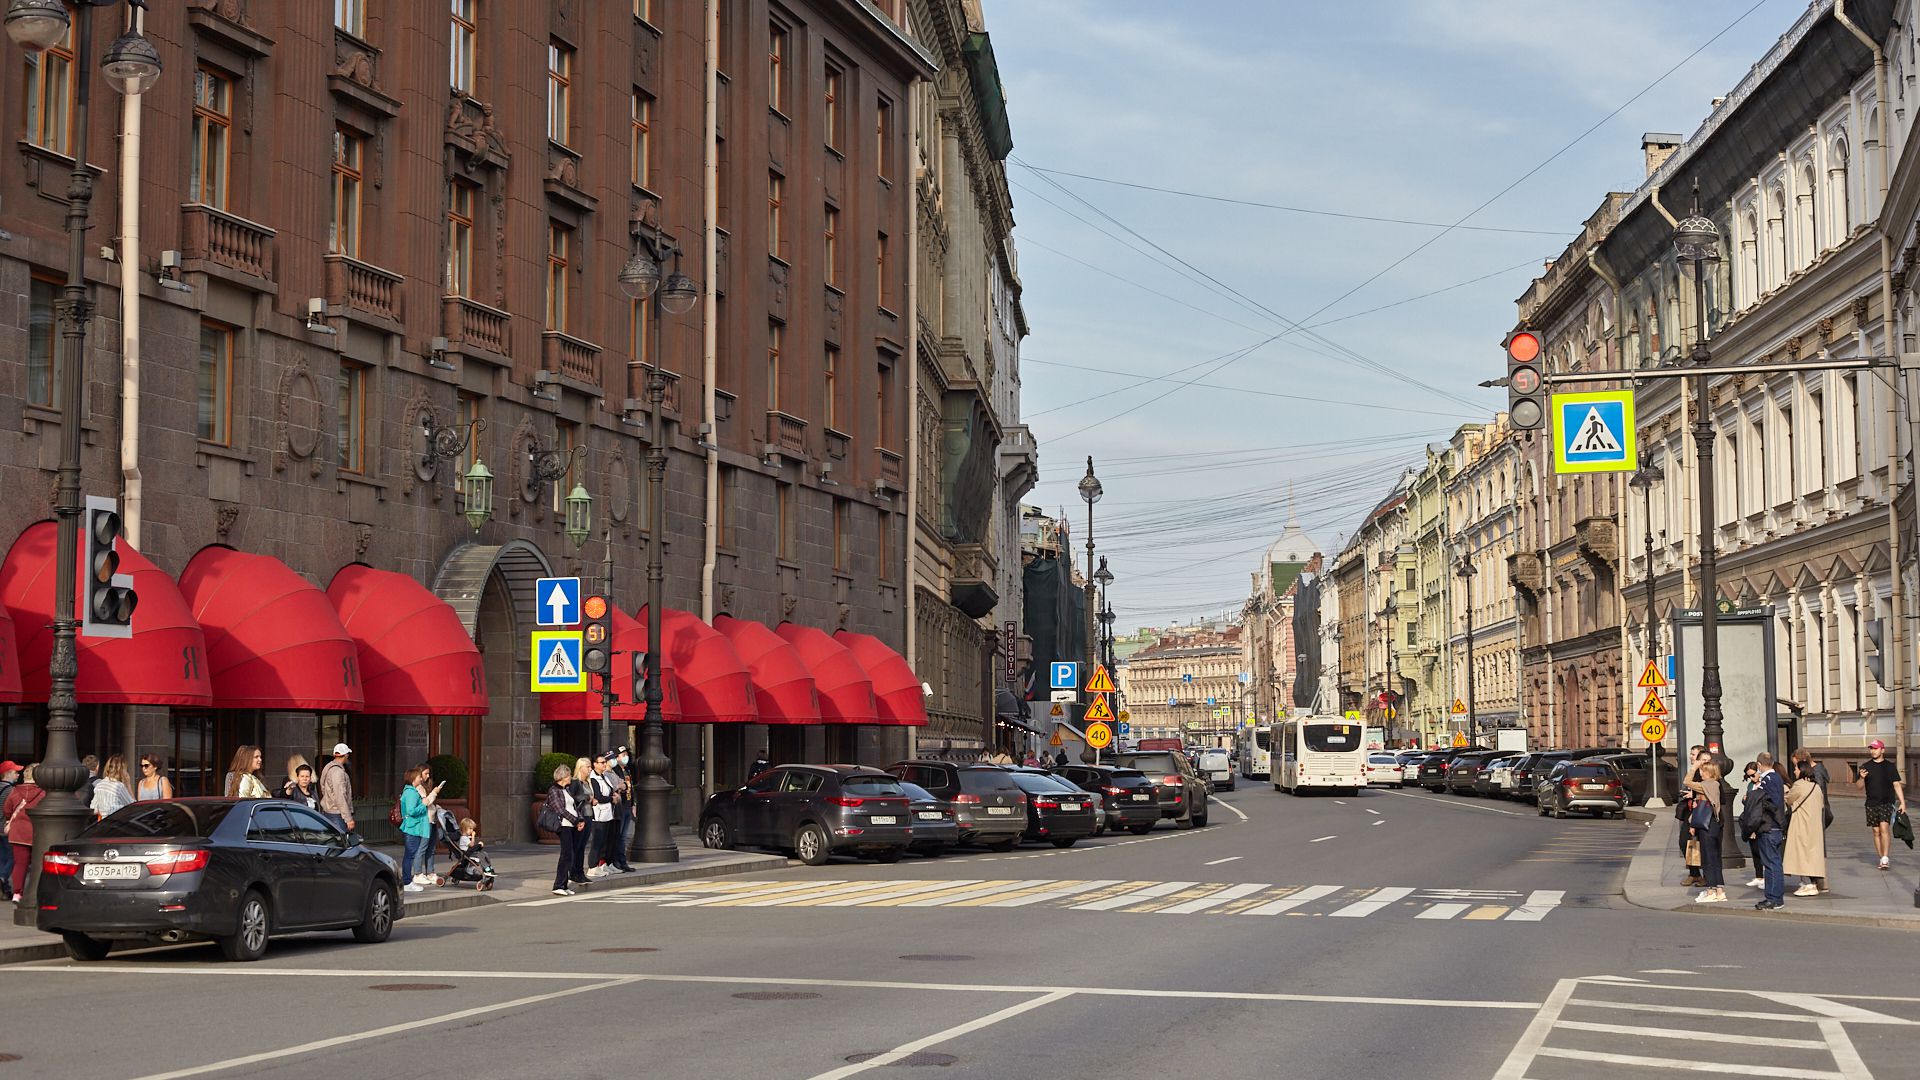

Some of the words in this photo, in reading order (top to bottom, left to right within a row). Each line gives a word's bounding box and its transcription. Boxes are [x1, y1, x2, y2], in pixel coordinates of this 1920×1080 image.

[1516, 372, 1538, 389] 51
[589, 626, 605, 641] 51
[1057, 665, 1072, 685] P
[1091, 730, 1106, 741] 40
[1646, 725, 1661, 735] 40
[124, 865, 137, 874] 178
